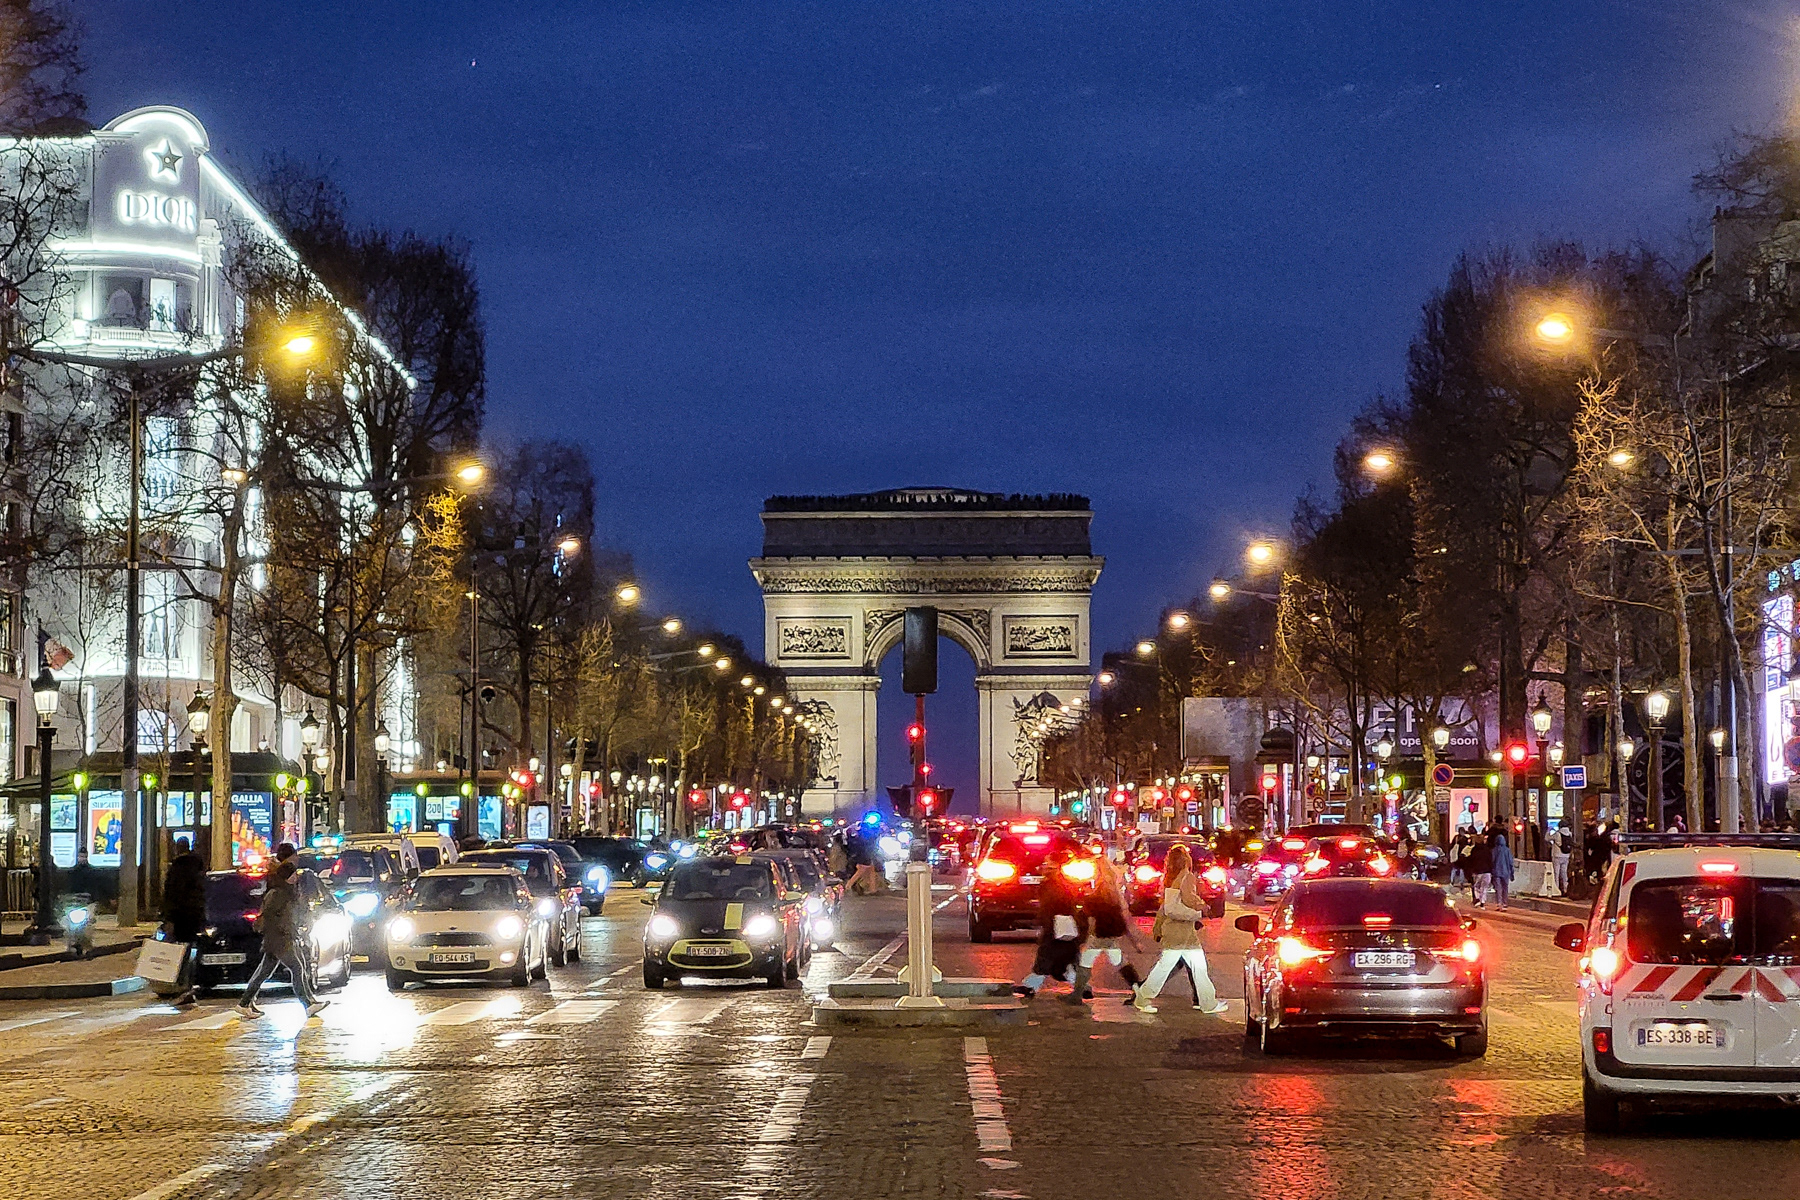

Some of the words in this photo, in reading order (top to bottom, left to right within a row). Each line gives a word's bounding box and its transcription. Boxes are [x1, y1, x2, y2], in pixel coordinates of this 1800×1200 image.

[123, 192, 197, 231] DIOR
[1450, 737, 1479, 746] soon
[231, 794, 264, 804] GALLIA
[1357, 953, 1409, 966] EX-296-RG
[1646, 1029, 1714, 1044] ES-338-BE
